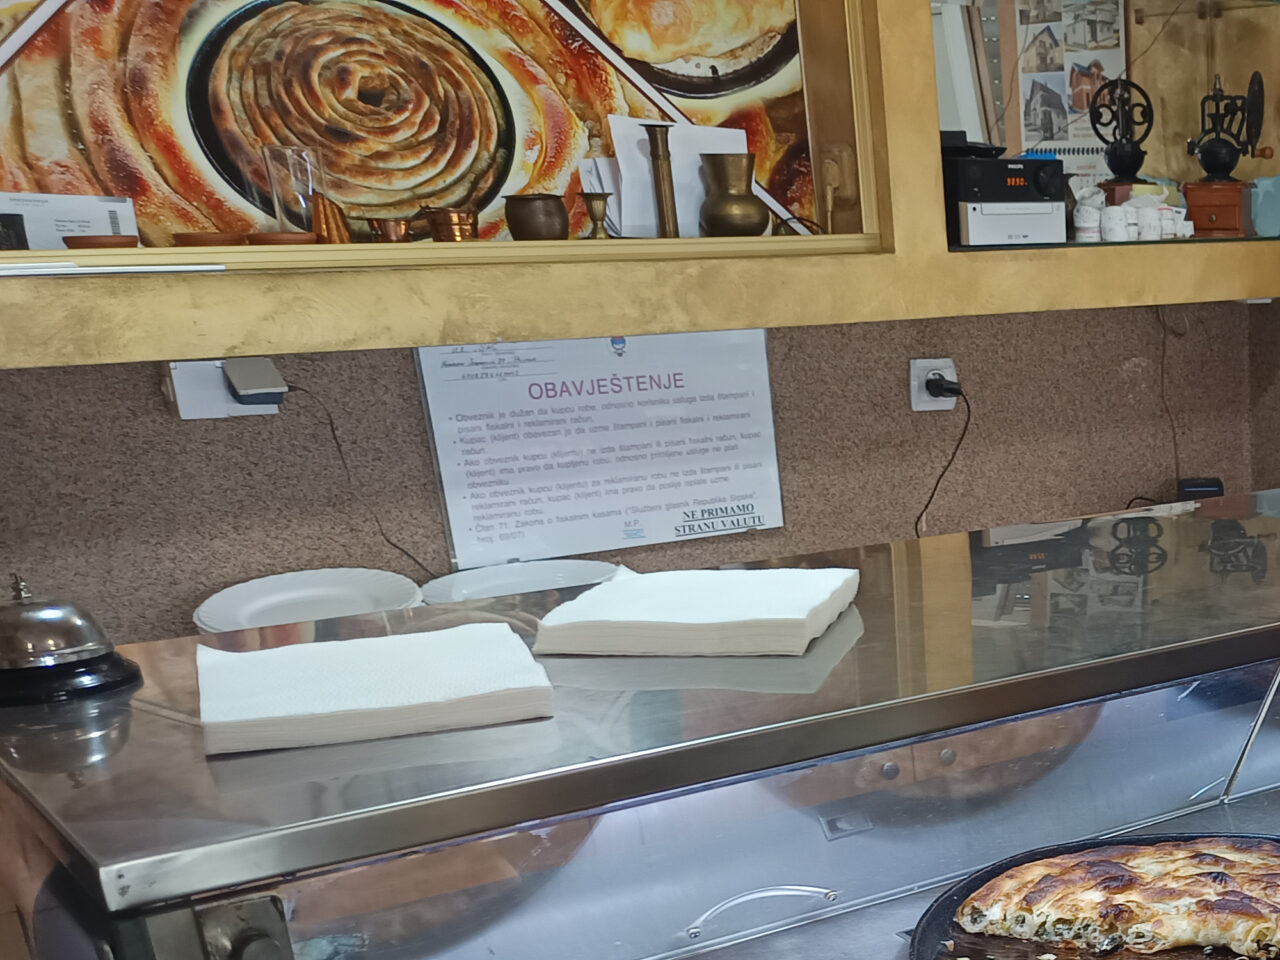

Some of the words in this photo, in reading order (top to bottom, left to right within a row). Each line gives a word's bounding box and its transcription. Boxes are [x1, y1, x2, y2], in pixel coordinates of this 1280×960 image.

[528, 372, 686, 400] OBAVJEŠTENJE
[683, 509, 698, 521] NE
[701, 503, 754, 519] PRIMAMO
[674, 519, 718, 535] STRANU
[721, 515, 765, 529] VALUTU
